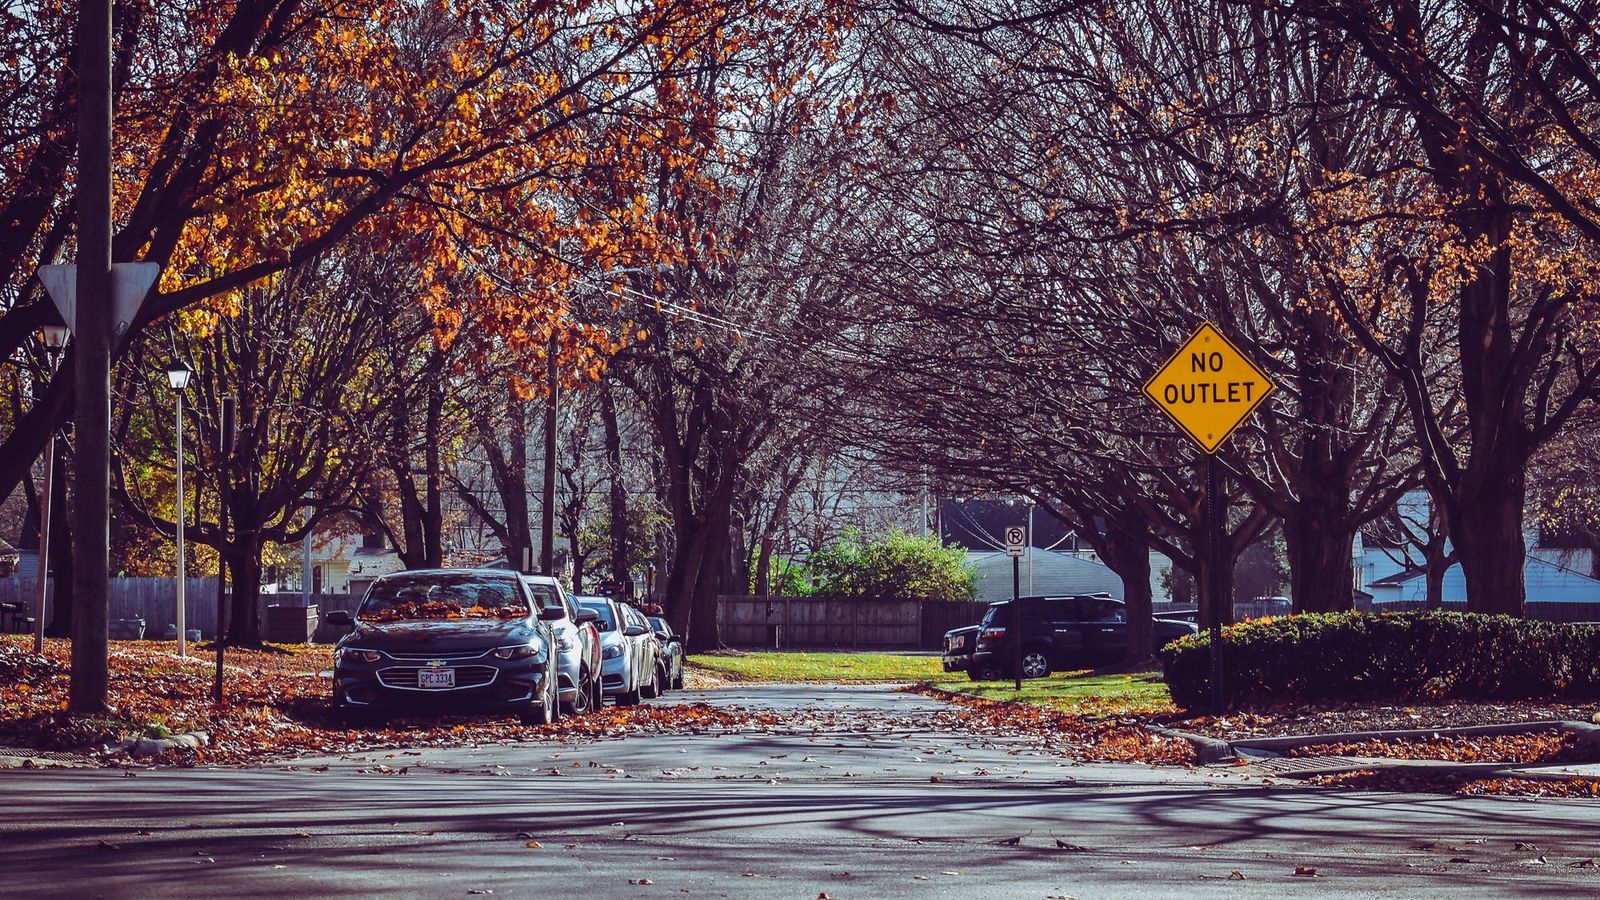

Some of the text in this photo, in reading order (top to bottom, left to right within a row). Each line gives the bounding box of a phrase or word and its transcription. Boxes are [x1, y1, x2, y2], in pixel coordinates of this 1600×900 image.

[1191, 352, 1224, 373] NO
[1164, 382, 1255, 404] OUTLET
[420, 673, 433, 684] GPC
